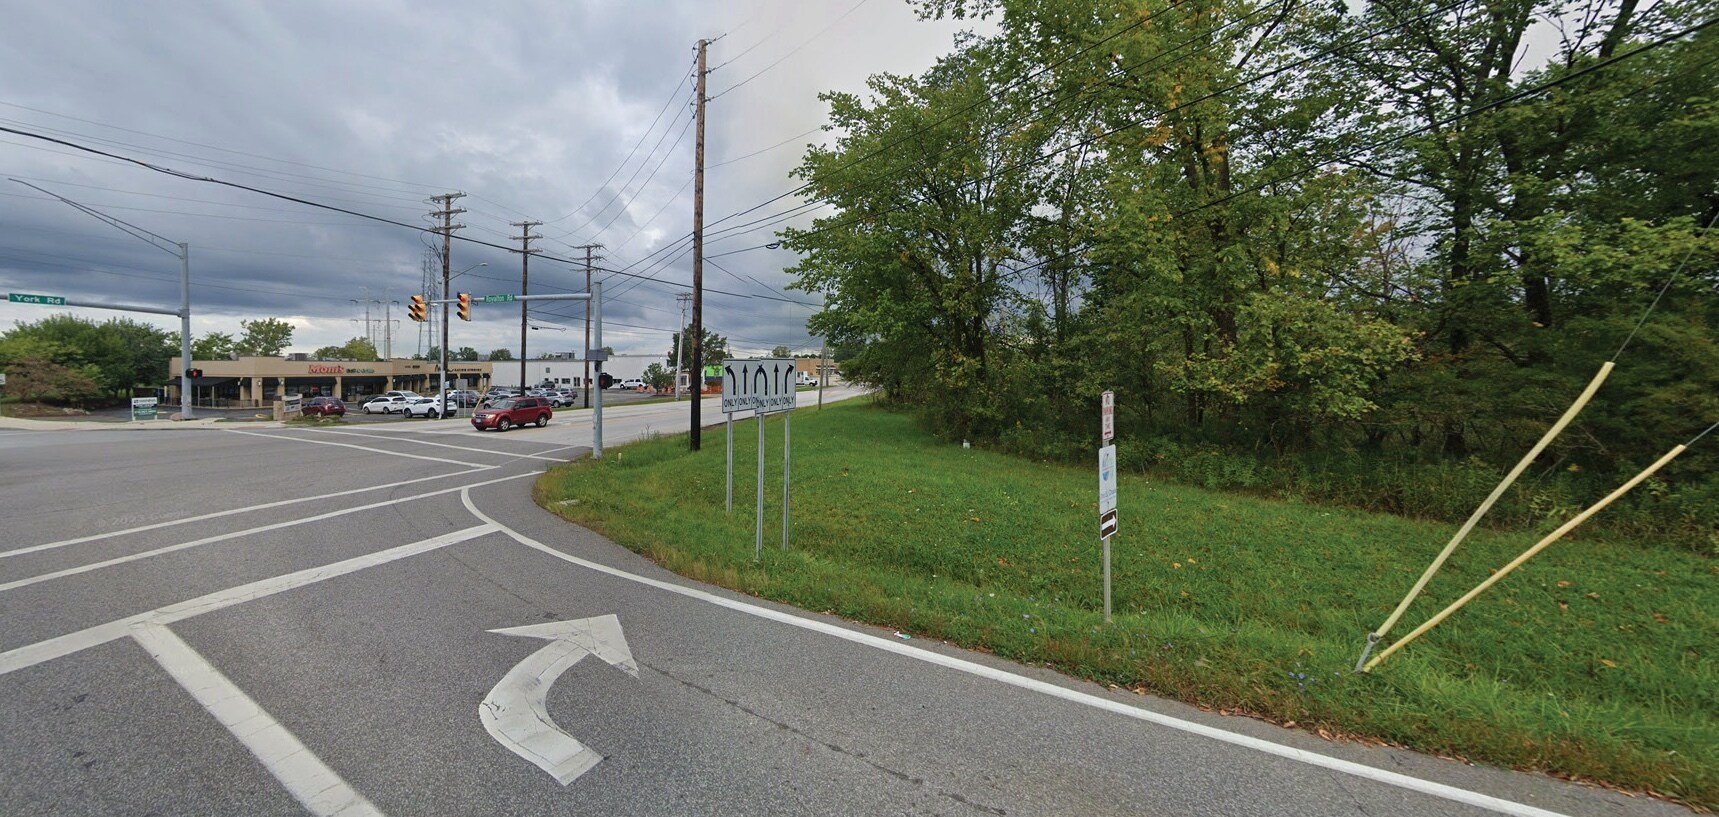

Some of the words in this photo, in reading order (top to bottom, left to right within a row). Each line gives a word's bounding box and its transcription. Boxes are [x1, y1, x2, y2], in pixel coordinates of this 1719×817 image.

[15, 294, 40, 303] York
[506, 294, 513, 302] Rd
[724, 398, 737, 407] ONLY
[739, 397, 751, 406] ONLY
[770, 397, 783, 406] ONLY
[783, 396, 795, 406] ONLY
